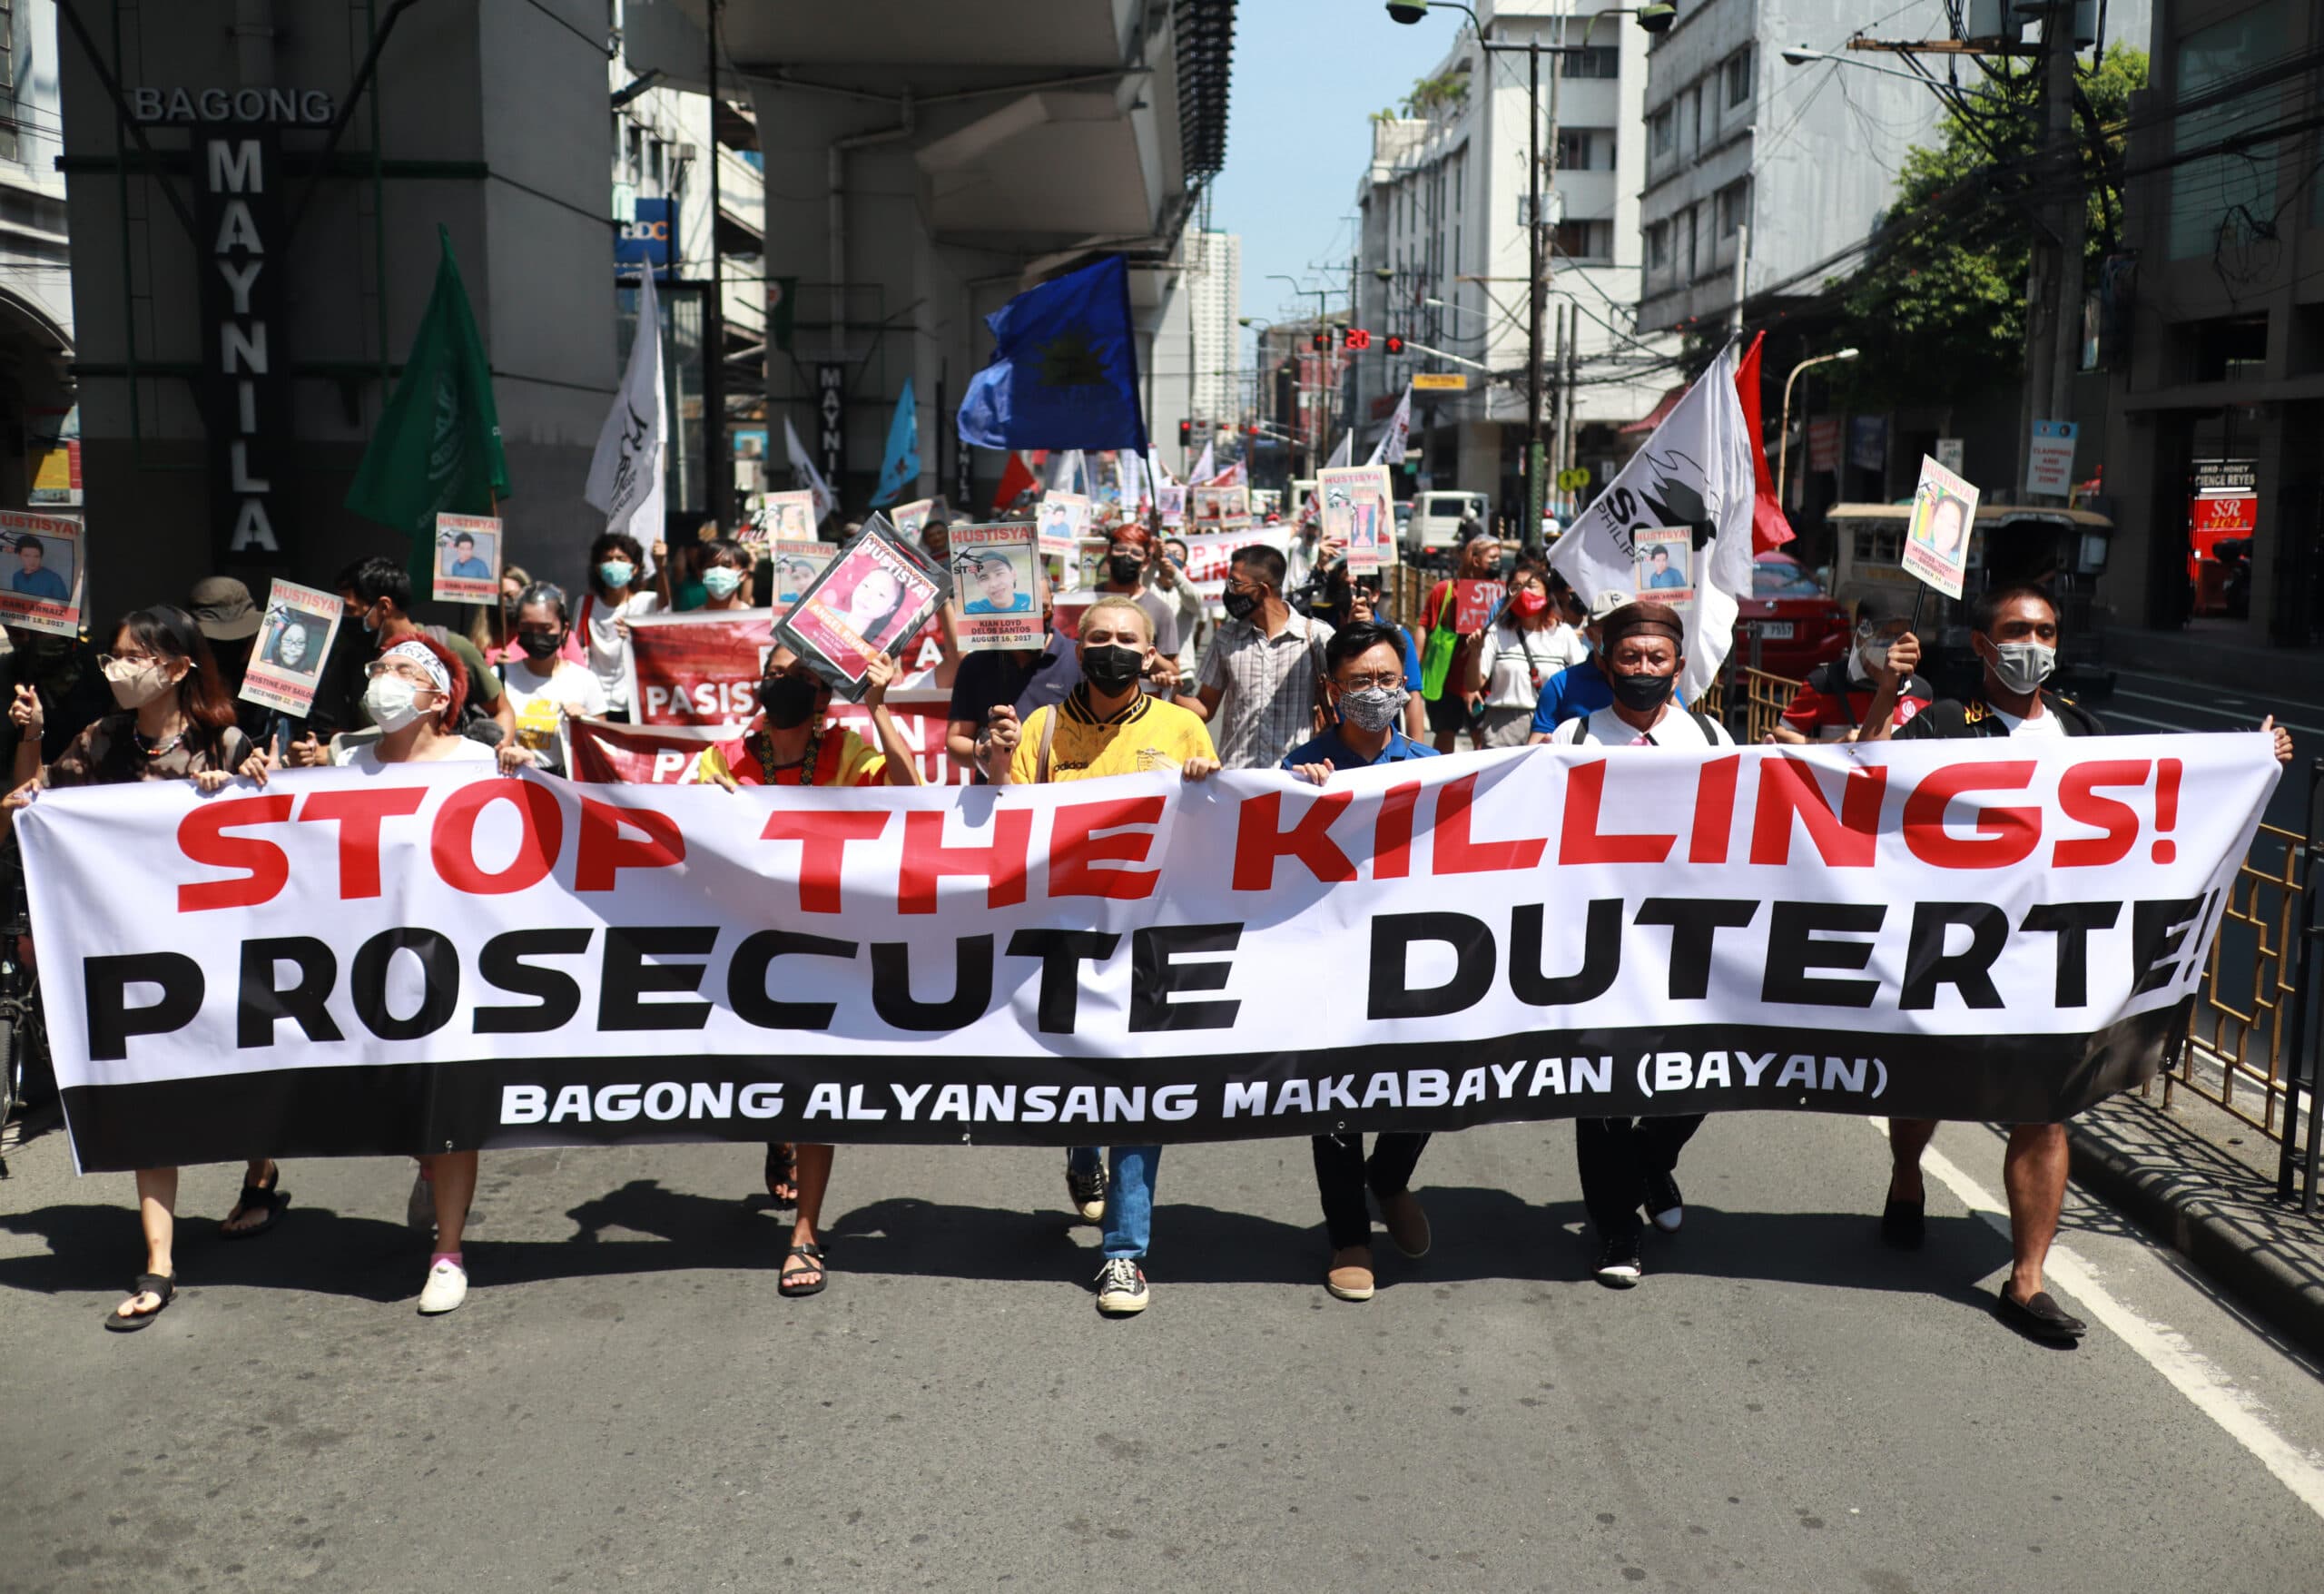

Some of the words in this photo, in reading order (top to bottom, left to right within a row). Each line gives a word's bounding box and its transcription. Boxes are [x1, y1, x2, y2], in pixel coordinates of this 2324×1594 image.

[134, 87, 335, 123] BAGONG
[207, 139, 279, 552] MAYNILA
[1345, 328, 1371, 349] 20
[821, 367, 842, 502] MAYNIL
[2228, 473, 2256, 487] REYES
[0, 515, 80, 536] USTISYA!
[950, 526, 1035, 544] HUSTISYA!
[1594, 501, 1635, 565] PHILIP
[272, 584, 341, 615] HUSTISYA!
[1000, 625, 1031, 634] SANTOS
[1014, 635, 1032, 643] 2017
[1054, 761, 1089, 772] adidas
[177, 778, 687, 912] STOP
[761, 795, 1167, 915] THE
[1232, 753, 2183, 891] KILLINGS!
[83, 921, 1245, 1061] PROSECUTE
[1367, 887, 2221, 1020] DUTERTE!
[499, 1081, 783, 1125] BAGONG
[803, 1083, 1198, 1123] ALYANSANG
[1222, 1056, 1613, 1118] MAKABAYAN
[1637, 1050, 1888, 1098] (BAYAN)
